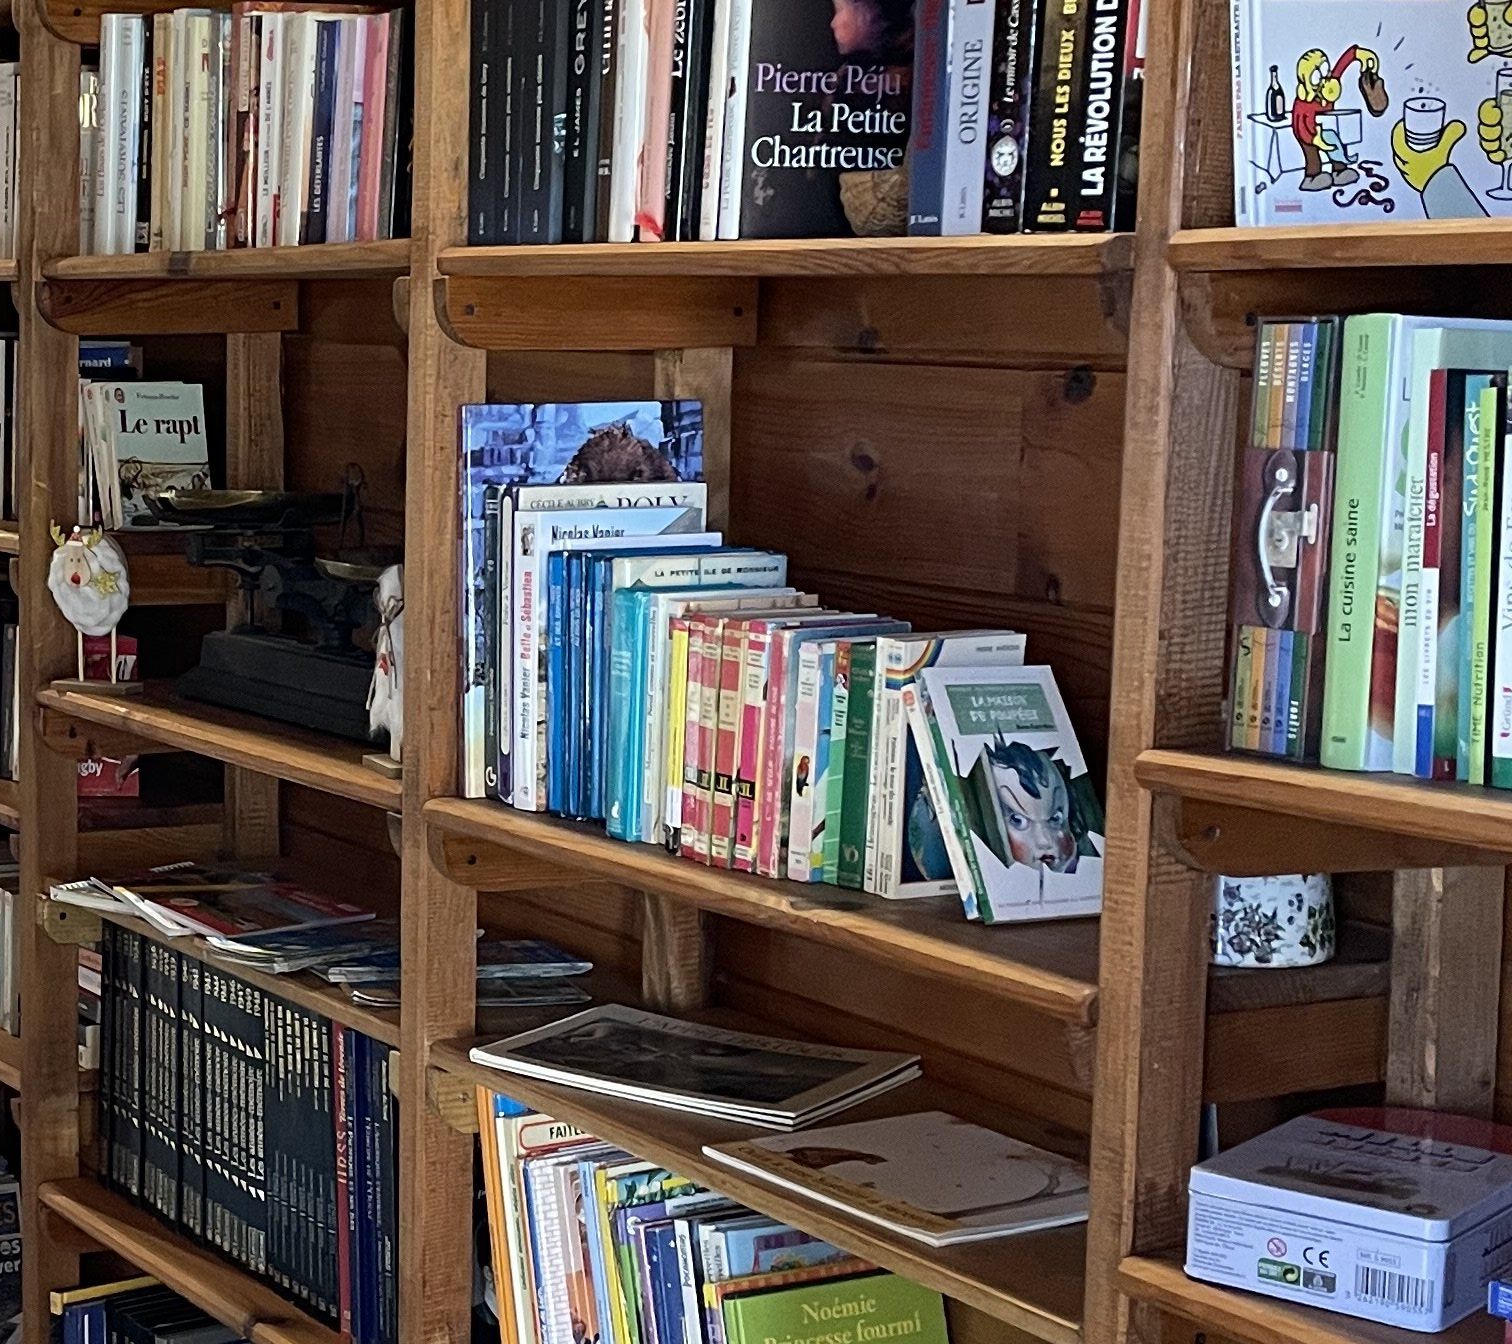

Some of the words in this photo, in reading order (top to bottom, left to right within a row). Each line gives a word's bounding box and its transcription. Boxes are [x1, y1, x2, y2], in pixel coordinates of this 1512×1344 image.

[1057, 29, 1075, 80] DIEUX
[754, 63, 838, 93] Pierre
[845, 65, 902, 103] Péju
[958, 39, 984, 145] ORIGINE
[1055, 85, 1070, 113] LES
[1078, 17, 1117, 162] RÉVOLUTION
[574, 87, 582, 134] JAMES
[790, 102, 823, 133] La
[830, 103, 906, 134] Petite
[751, 135, 903, 169] Chartreuse
[1049, 119, 1067, 167] NOUS
[1081, 167, 1104, 196] LA
[117, 187, 125, 215] LES
[313, 197, 322, 213] LES
[1258, 340, 1271, 386] FLEUVES
[1286, 340, 1299, 403] MONTAGNES
[118, 409, 148, 435] Le
[154, 415, 201, 444] rapt
[1426, 452, 1440, 512] dégustation
[1345, 498, 1360, 546] saine
[1426, 513, 1437, 527] La
[654, 570, 665, 578] LA
[1340, 553, 1357, 616] cuisine
[520, 570, 533, 623] Sébastien
[1403, 583, 1419, 628] mon
[520, 632, 531, 660] Belle
[1338, 622, 1351, 643] La
[520, 666, 531, 700] Vanier
[801, 1294, 877, 1325] Noémie
[856, 1310, 922, 1342] fourmi
